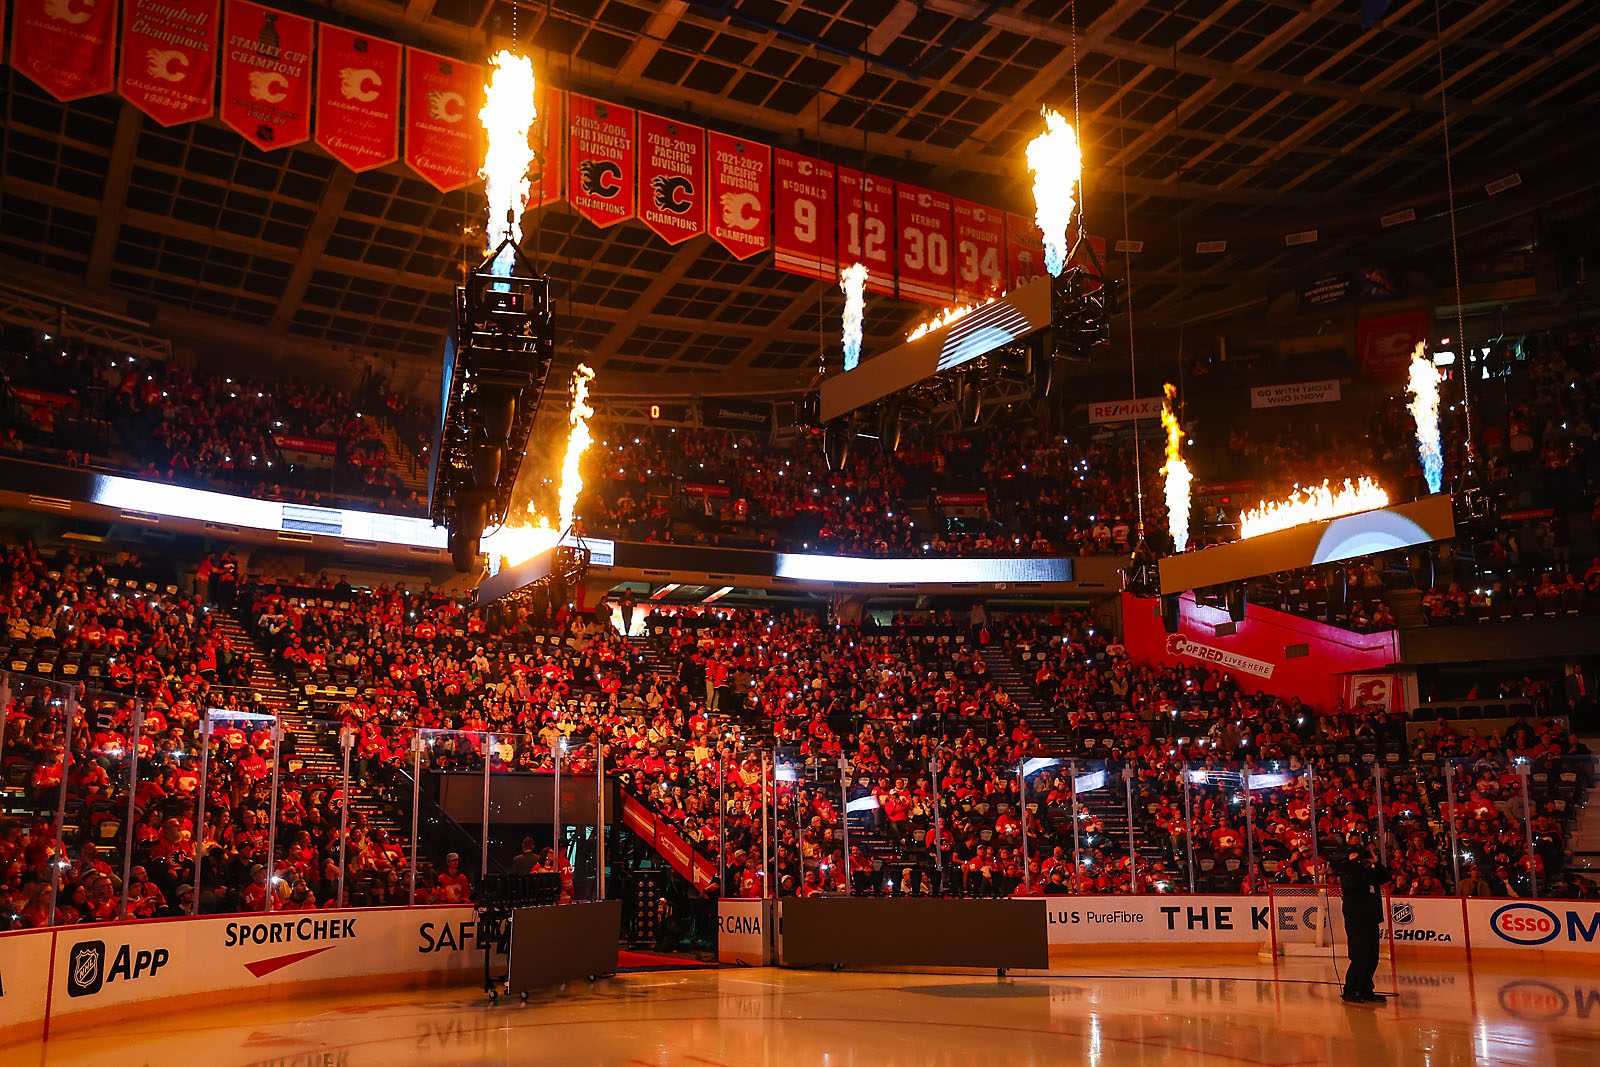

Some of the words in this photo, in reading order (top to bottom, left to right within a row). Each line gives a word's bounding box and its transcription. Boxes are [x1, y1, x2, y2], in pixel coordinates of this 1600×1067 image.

[137, 0, 208, 26] Campbell
[131, 20, 209, 52] Champions
[229, 35, 282, 57] STANLEY
[284, 50, 308, 64] CUP
[231, 51, 302, 78] CHAMPIONS
[126, 78, 170, 94] CALGARY
[144, 93, 188, 110] 1988-89
[327, 100, 360, 112] CALGARY
[361, 108, 388, 119] FLAMES
[415, 121, 446, 133] CALGARY
[326, 134, 387, 158] Champions
[570, 125, 631, 151] NORTHWEST
[647, 132, 696, 155] 2018-2019
[579, 139, 623, 161] DIVISION
[654, 145, 690, 164] PACIFIC
[651, 155, 693, 176] DIVISION
[716, 151, 763, 172] 2021-2022
[723, 163, 757, 181] PACIFIC
[720, 173, 759, 193] DIVISION
[575, 195, 625, 216] CHAMPIONS
[646, 209, 697, 232] CHAMPIONS
[794, 197, 816, 244] 9
[911, 213, 941, 229] VERNON
[715, 226, 765, 247] CHAMPIONS
[847, 212, 886, 262] 12
[903, 226, 948, 276] 30
[959, 240, 1000, 284] 34
[1267, 395, 1292, 403] WHO
[1294, 392, 1325, 401] KNOW
[1275, 386, 1300, 396] WITH
[1303, 384, 1335, 393] THOSE
[1095, 403, 1149, 417] RE/MAX
[1186, 644, 1199, 654] OF
[1198, 648, 1223, 662] RED
[1224, 655, 1247, 668] LIVES
[1248, 663, 1270, 674] HERE
[1087, 911, 1144, 923] PureFibre
[1160, 907, 1234, 930] THE
[1395, 908, 1411, 921] NHL
[225, 918, 357, 946] SPORTCHEK
[727, 916, 761, 935] CANA
[1566, 911, 1600, 942] M
[79, 959, 95, 980] NHL
